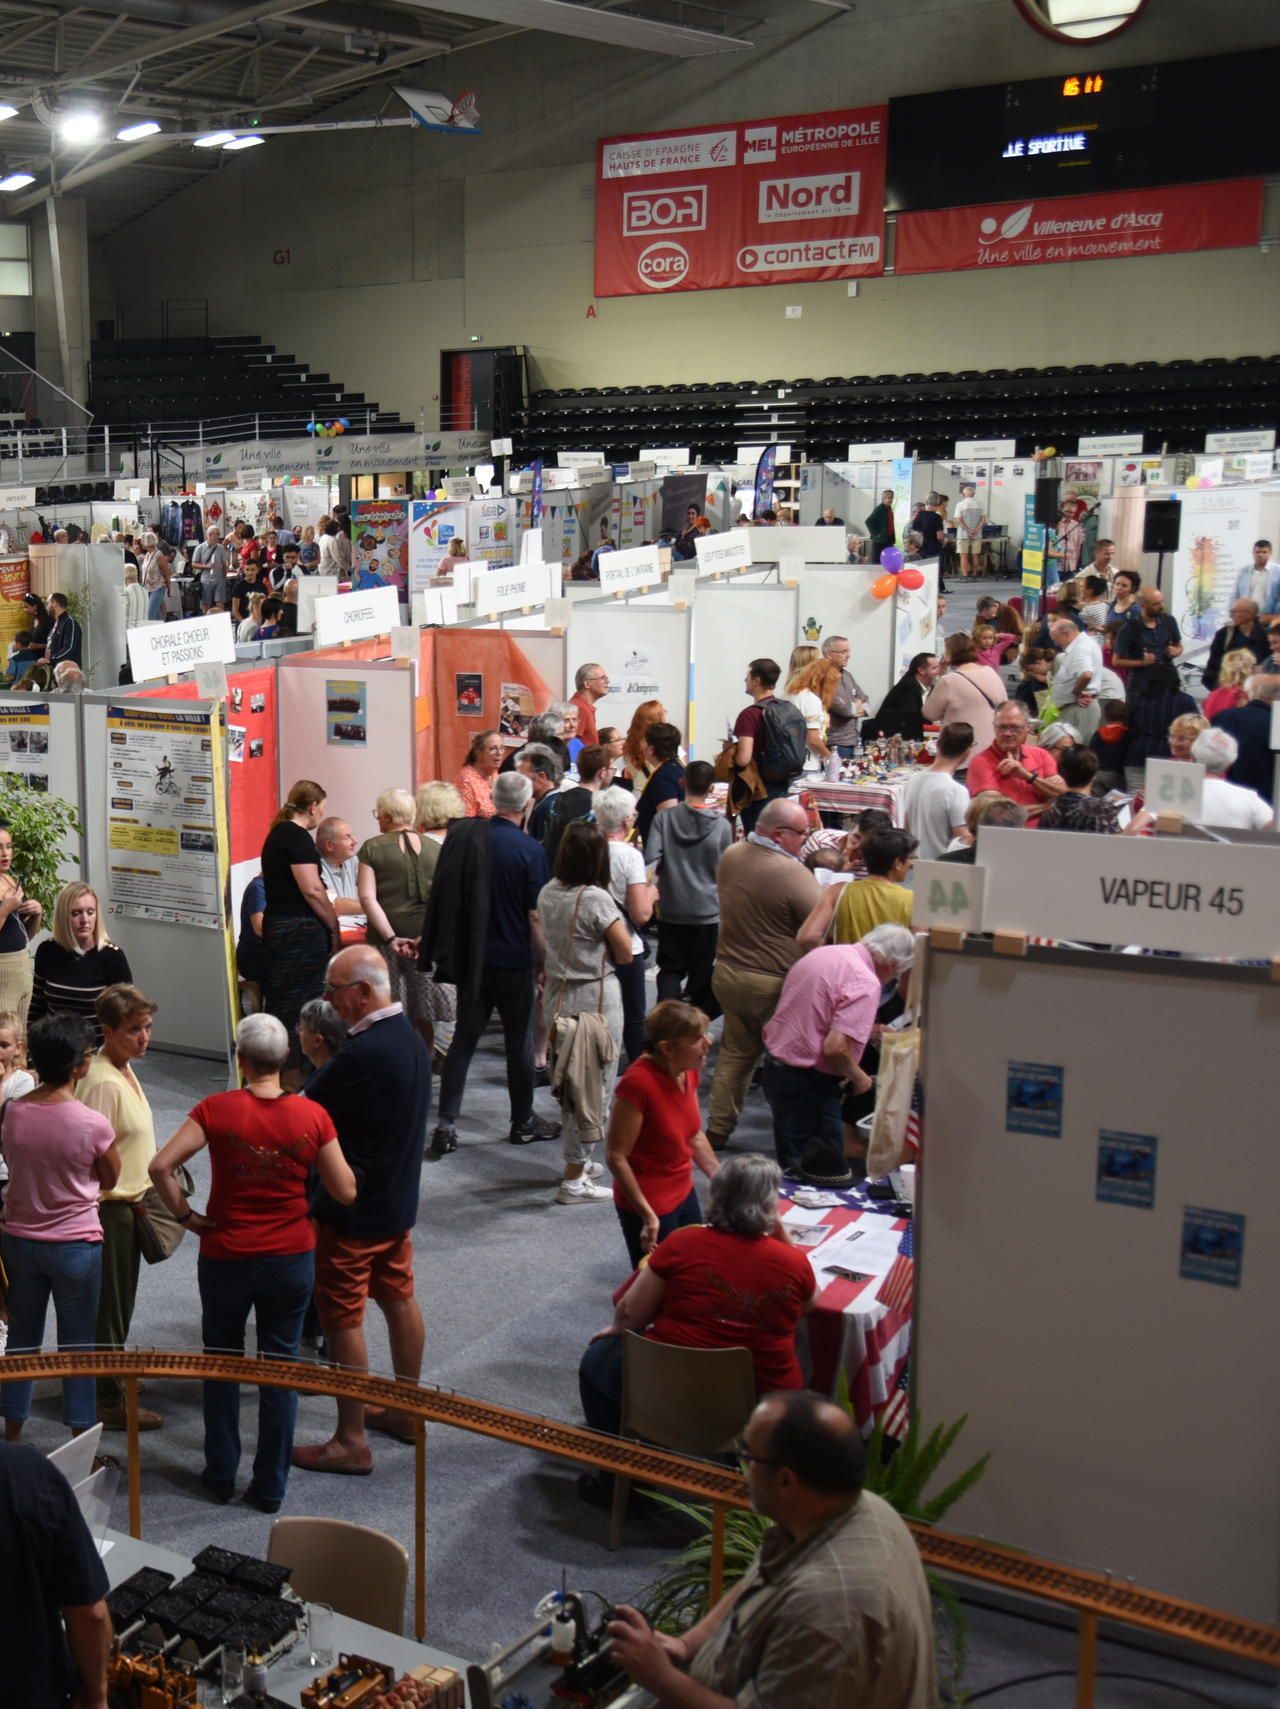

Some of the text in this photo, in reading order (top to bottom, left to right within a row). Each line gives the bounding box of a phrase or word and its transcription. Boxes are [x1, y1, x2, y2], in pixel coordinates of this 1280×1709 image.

[781, 121, 881, 145] MÉTROPOLE
[609, 143, 701, 161] CAISSE D'EPARGNE
[744, 138, 777, 154] MEL
[781, 136, 880, 154] EUROPÉENNE DE LILLE
[608, 154, 701, 172] HAUTS DE FRANCE
[765, 175, 853, 211] Nord
[630, 195, 699, 227] BOA
[1032, 212, 1163, 236] Villeneuve d'Ascq
[977, 235, 1162, 265] Une ville en mouvement
[640, 256, 685, 274] cora
[585, 304, 597, 319] A
[239, 447, 282, 461] Une ville
[350, 442, 392, 455] Une ville
[350, 455, 420, 468] en mouvement
[150, 627, 210, 649] CHORALE CHOEUR
[161, 645, 205, 666] ET PASSIONS
[1100, 876, 1245, 916] VAPEUR 45
